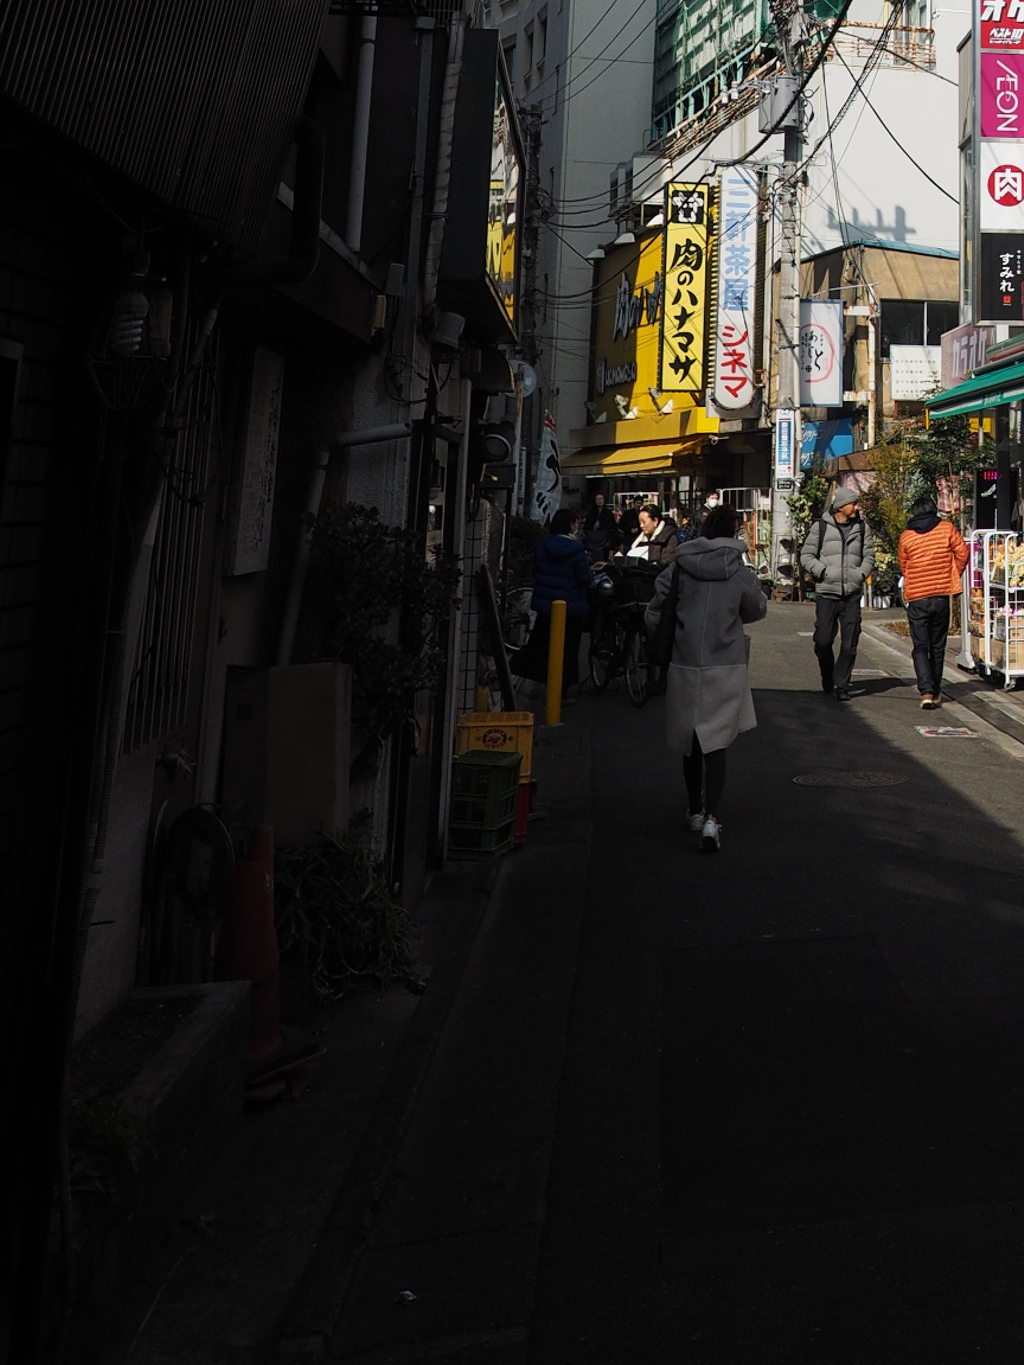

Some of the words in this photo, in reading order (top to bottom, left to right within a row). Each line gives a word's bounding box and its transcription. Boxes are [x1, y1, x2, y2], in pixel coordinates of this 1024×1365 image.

[994, 168, 1022, 202] 肉
[723, 178, 751, 311] 三軒茶屋
[1000, 252, 1015, 293] すみれ
[670, 238, 703, 384] 肉のハナマサ
[720, 325, 748, 398] シネマ
